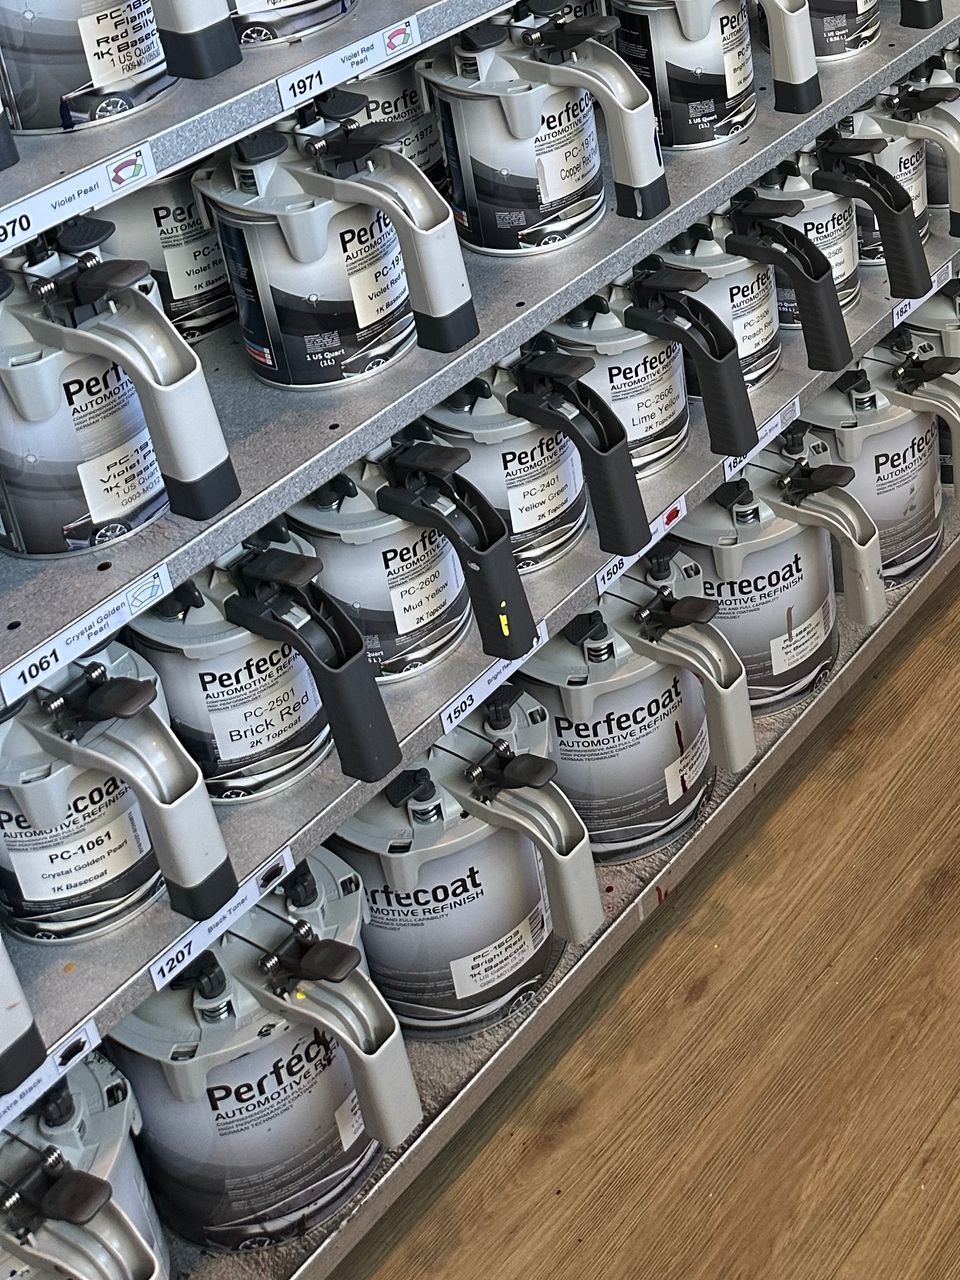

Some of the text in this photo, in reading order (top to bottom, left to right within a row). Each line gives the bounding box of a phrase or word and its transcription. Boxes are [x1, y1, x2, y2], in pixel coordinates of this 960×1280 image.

[97, 31, 128, 47] Red
[94, 48, 113, 60] 1K
[119, 53, 132, 64] US
[340, 44, 374, 64] Violet Red
[350, 56, 368, 68] Pearl
[289, 70, 323, 98] 1971
[51, 182, 100, 210] Violet Pearl
[186, 264, 211, 277] Violet
[368, 283, 389, 302] Violet
[896, 300, 911, 320] 1821
[325, 349, 345, 359] Quart
[637, 385, 673, 412] PC-2606
[632, 412, 656, 426] Lime
[100, 461, 140, 483] Violet
[505, 448, 558, 478] AUTOMOTIVE
[104, 483, 120, 494] 1K
[123, 484, 137, 494] US
[518, 483, 568, 514] Yellow Green
[523, 475, 560, 499] PC-2401
[400, 570, 440, 599] PC-2600
[600, 558, 626, 585] 1508
[403, 581, 449, 614] Mud Yellow
[760, 574, 803, 600] REFINISH
[426, 599, 447, 619] Topcoat
[65, 601, 126, 646] Crystal Golden
[87, 621, 110, 641] Pearl
[18, 648, 60, 685] 1061
[205, 670, 274, 700] AUTOMOTIVE
[229, 691, 309, 742] Brick Red
[244, 687, 296, 722] PC-2501
[445, 694, 475, 726] 1503
[554, 675, 682, 738] Perfecoat
[250, 715, 302, 749] 2K Topcoat
[559, 696, 683, 748] AUTOMOTIVE REFINISH
[83, 785, 131, 821] REFINISH
[42, 839, 128, 880] Crystal Golden Pearl
[49, 831, 112, 864] PC-1061
[52, 869, 107, 893] 1K Basecoat
[207, 894, 249, 935] Black Toner
[423, 889, 484, 916] REFINISH
[157, 941, 195, 981] 1207
[484, 941, 527, 973] Basecoat
[18, 1076, 43, 1103] Black
